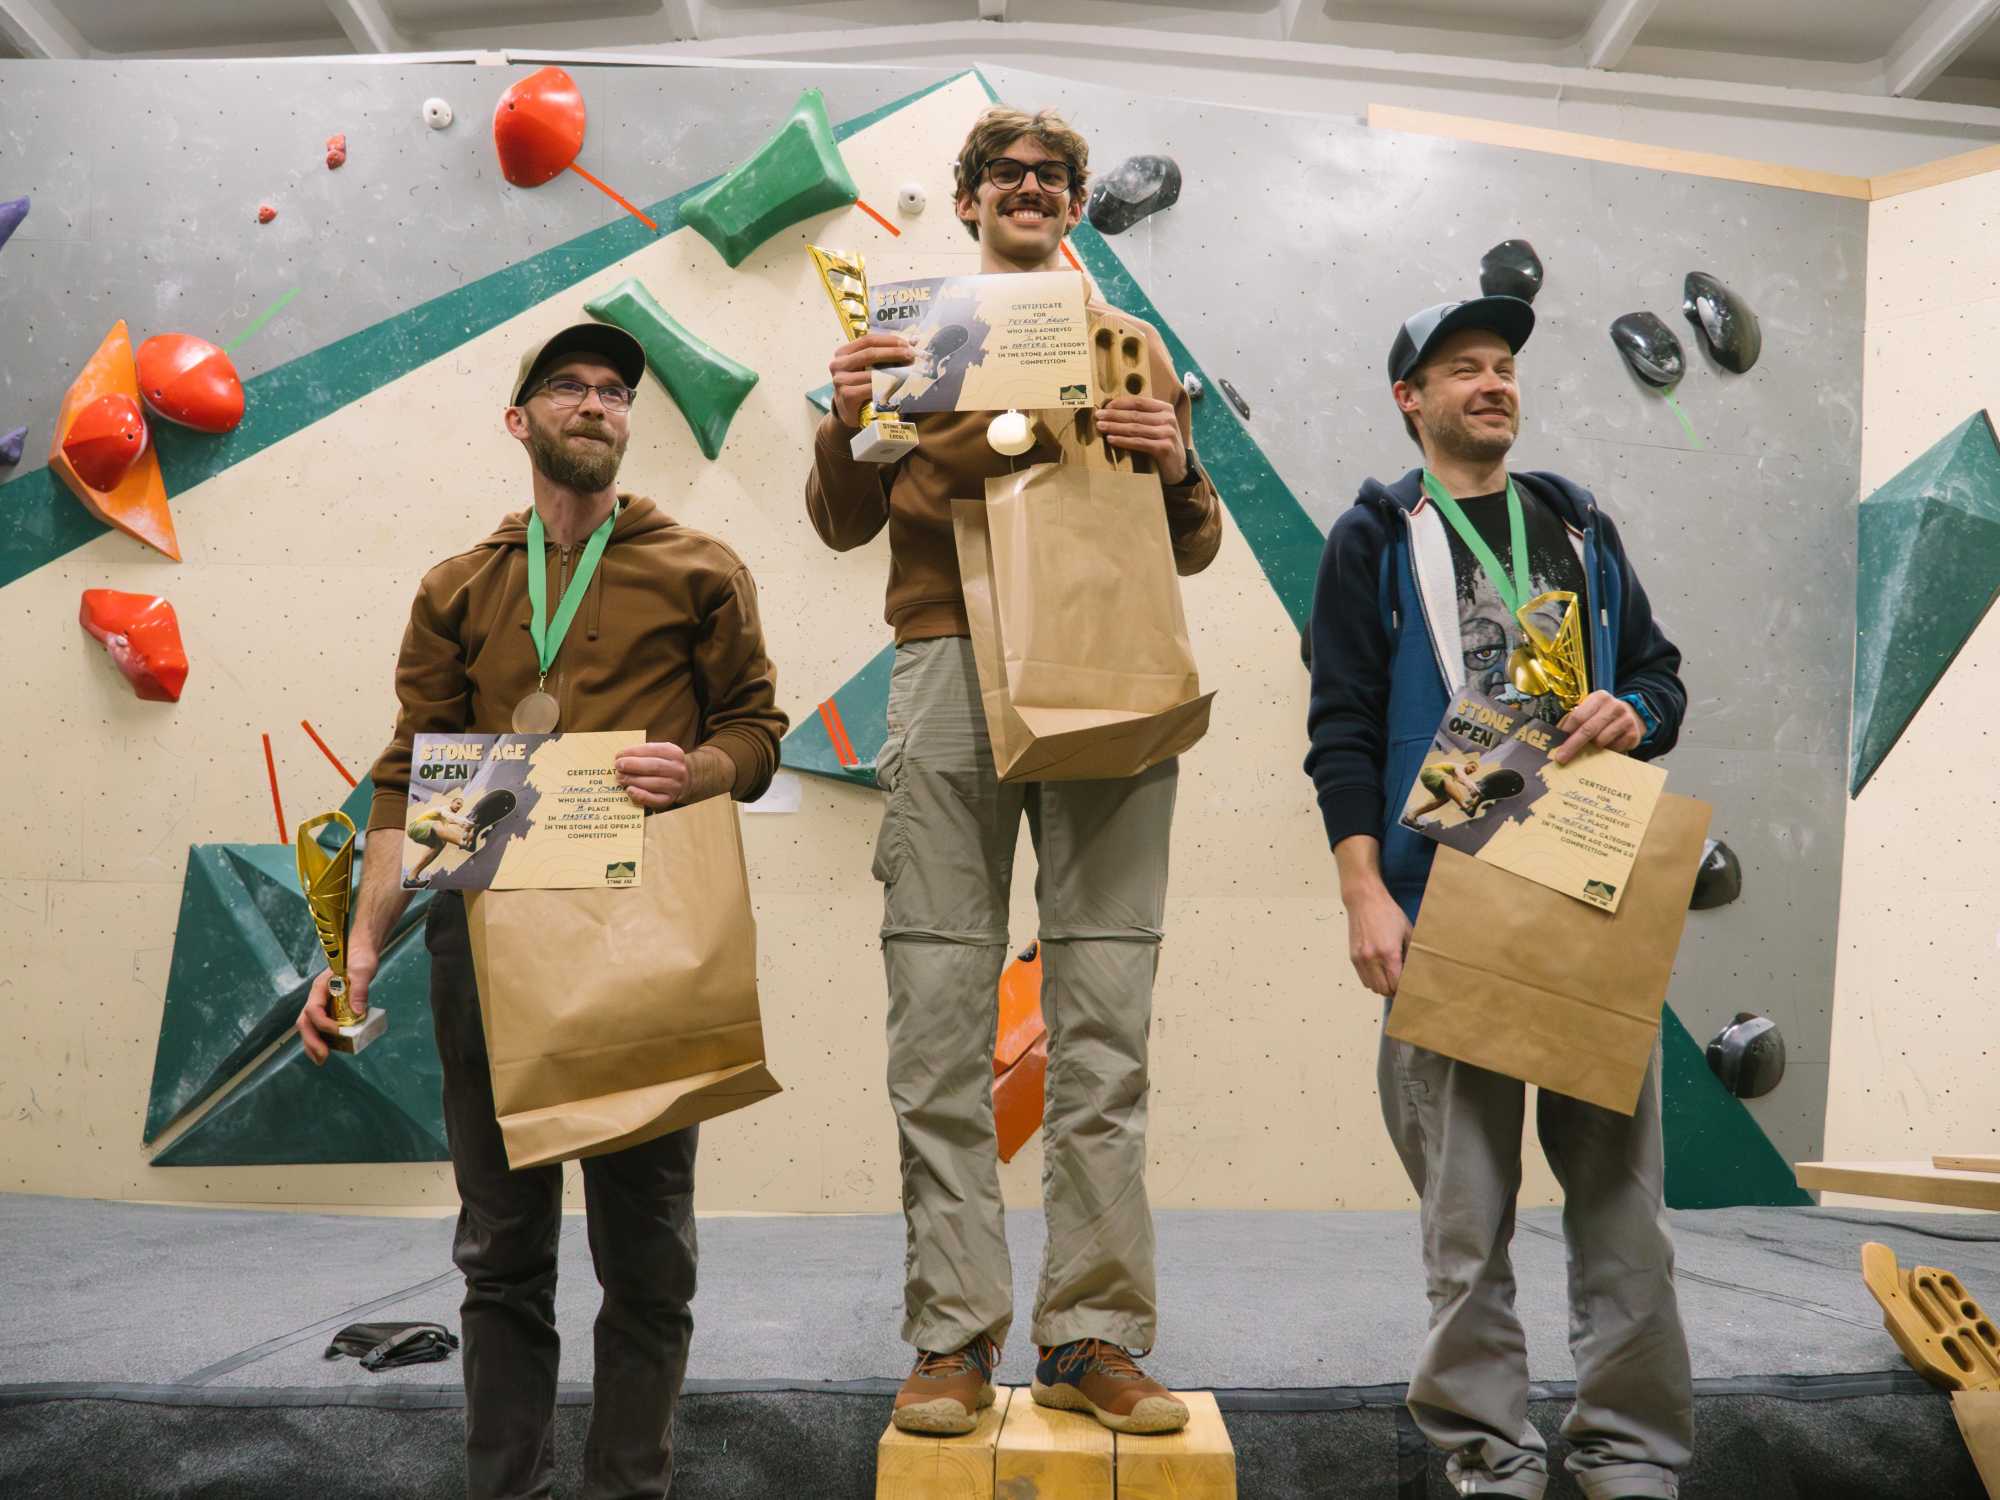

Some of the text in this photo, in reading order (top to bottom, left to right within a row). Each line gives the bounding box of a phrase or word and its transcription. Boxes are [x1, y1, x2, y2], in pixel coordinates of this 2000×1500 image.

[876, 286, 931, 306] STONE
[876, 305, 920, 322] OPEN
[1011, 302, 1063, 311] CERTIFICATE
[1448, 717, 1494, 747] OPEN
[1456, 698, 1552, 752] STONE AGE
[420, 743, 527, 761] STONE AGE
[418, 763, 468, 780] OPEN
[567, 768, 617, 776] CERTIFICAT
[1578, 777, 1632, 801] CERTIFICATE
[1587, 818, 1609, 830] PLACE
[1560, 836, 1609, 857] COMPETITION
[1565, 829, 1587, 841] STONE
[1602, 842, 1623, 854] OPEN
[1599, 832, 1636, 848] CATEGORY
